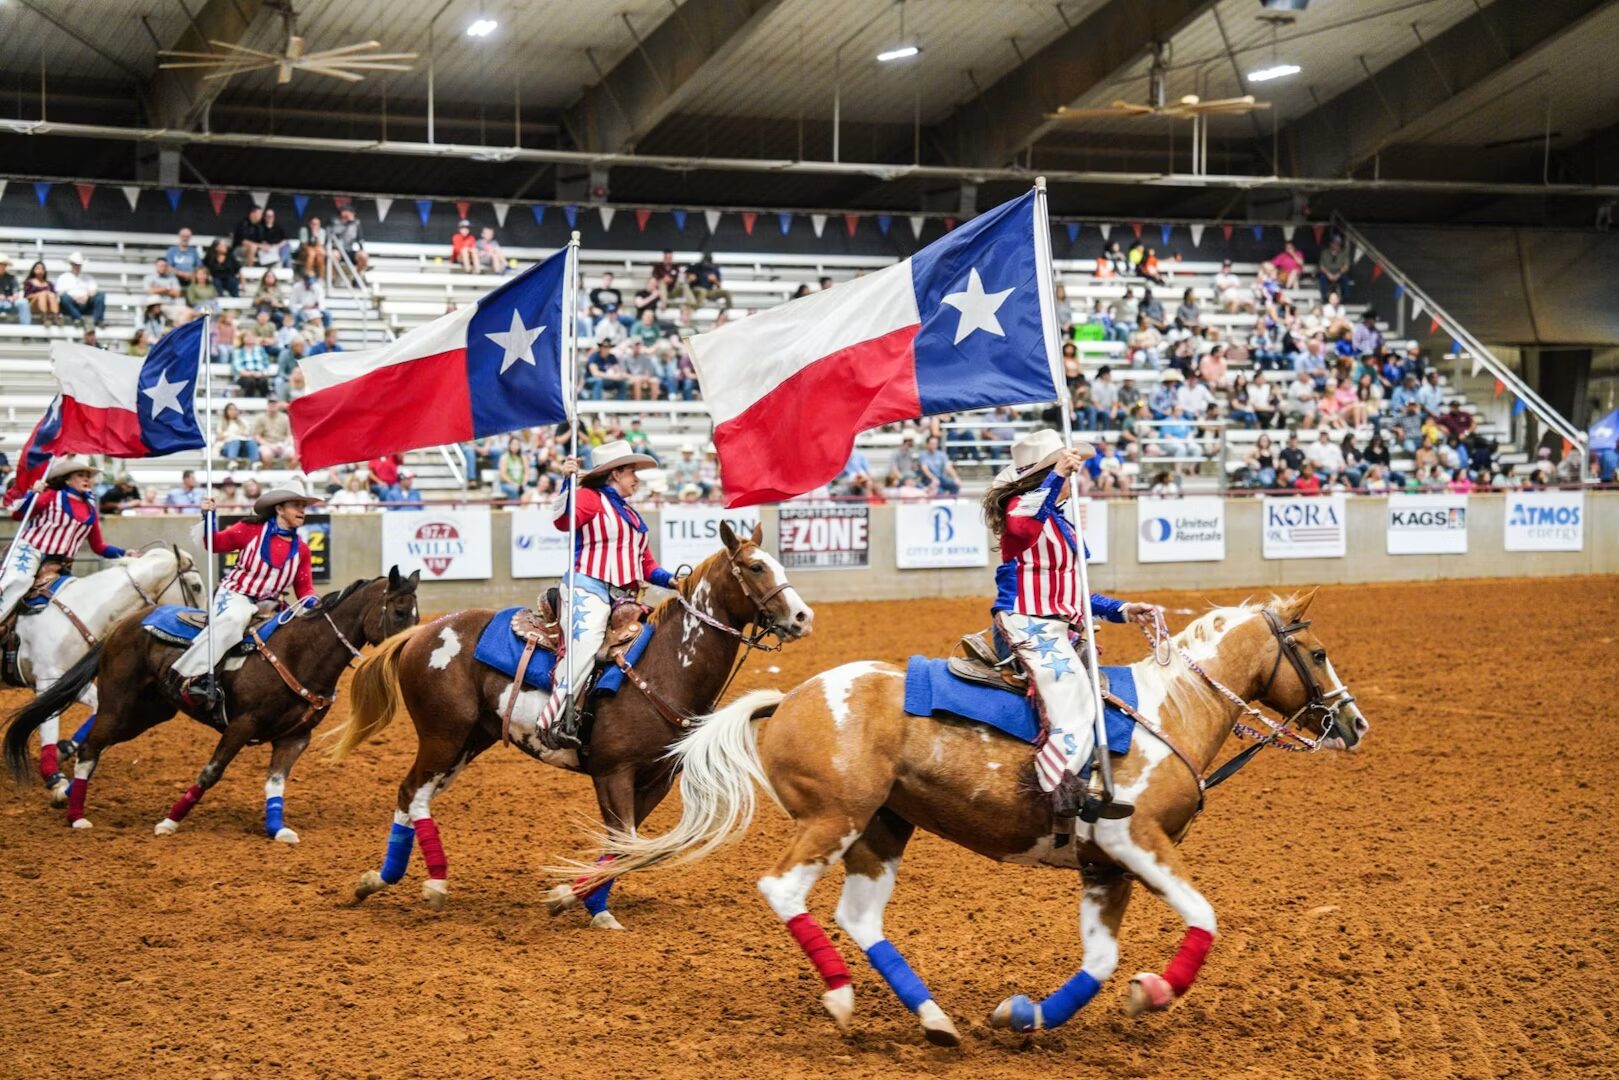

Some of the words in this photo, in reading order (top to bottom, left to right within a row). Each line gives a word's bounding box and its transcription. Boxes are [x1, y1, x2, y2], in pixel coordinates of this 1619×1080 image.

[1269, 503, 1338, 527] KORA
[1391, 511, 1448, 526] KAGS
[1510, 503, 1581, 525] ATMOS
[1175, 516, 1218, 528] United
[780, 519, 794, 552] THE
[793, 517, 868, 552] ZONE
[1174, 531, 1222, 542] Rentals
[1527, 527, 1578, 541] energy
[407, 540, 466, 555] WILLY
[906, 546, 929, 556] CITY
[931, 546, 944, 556] OF
